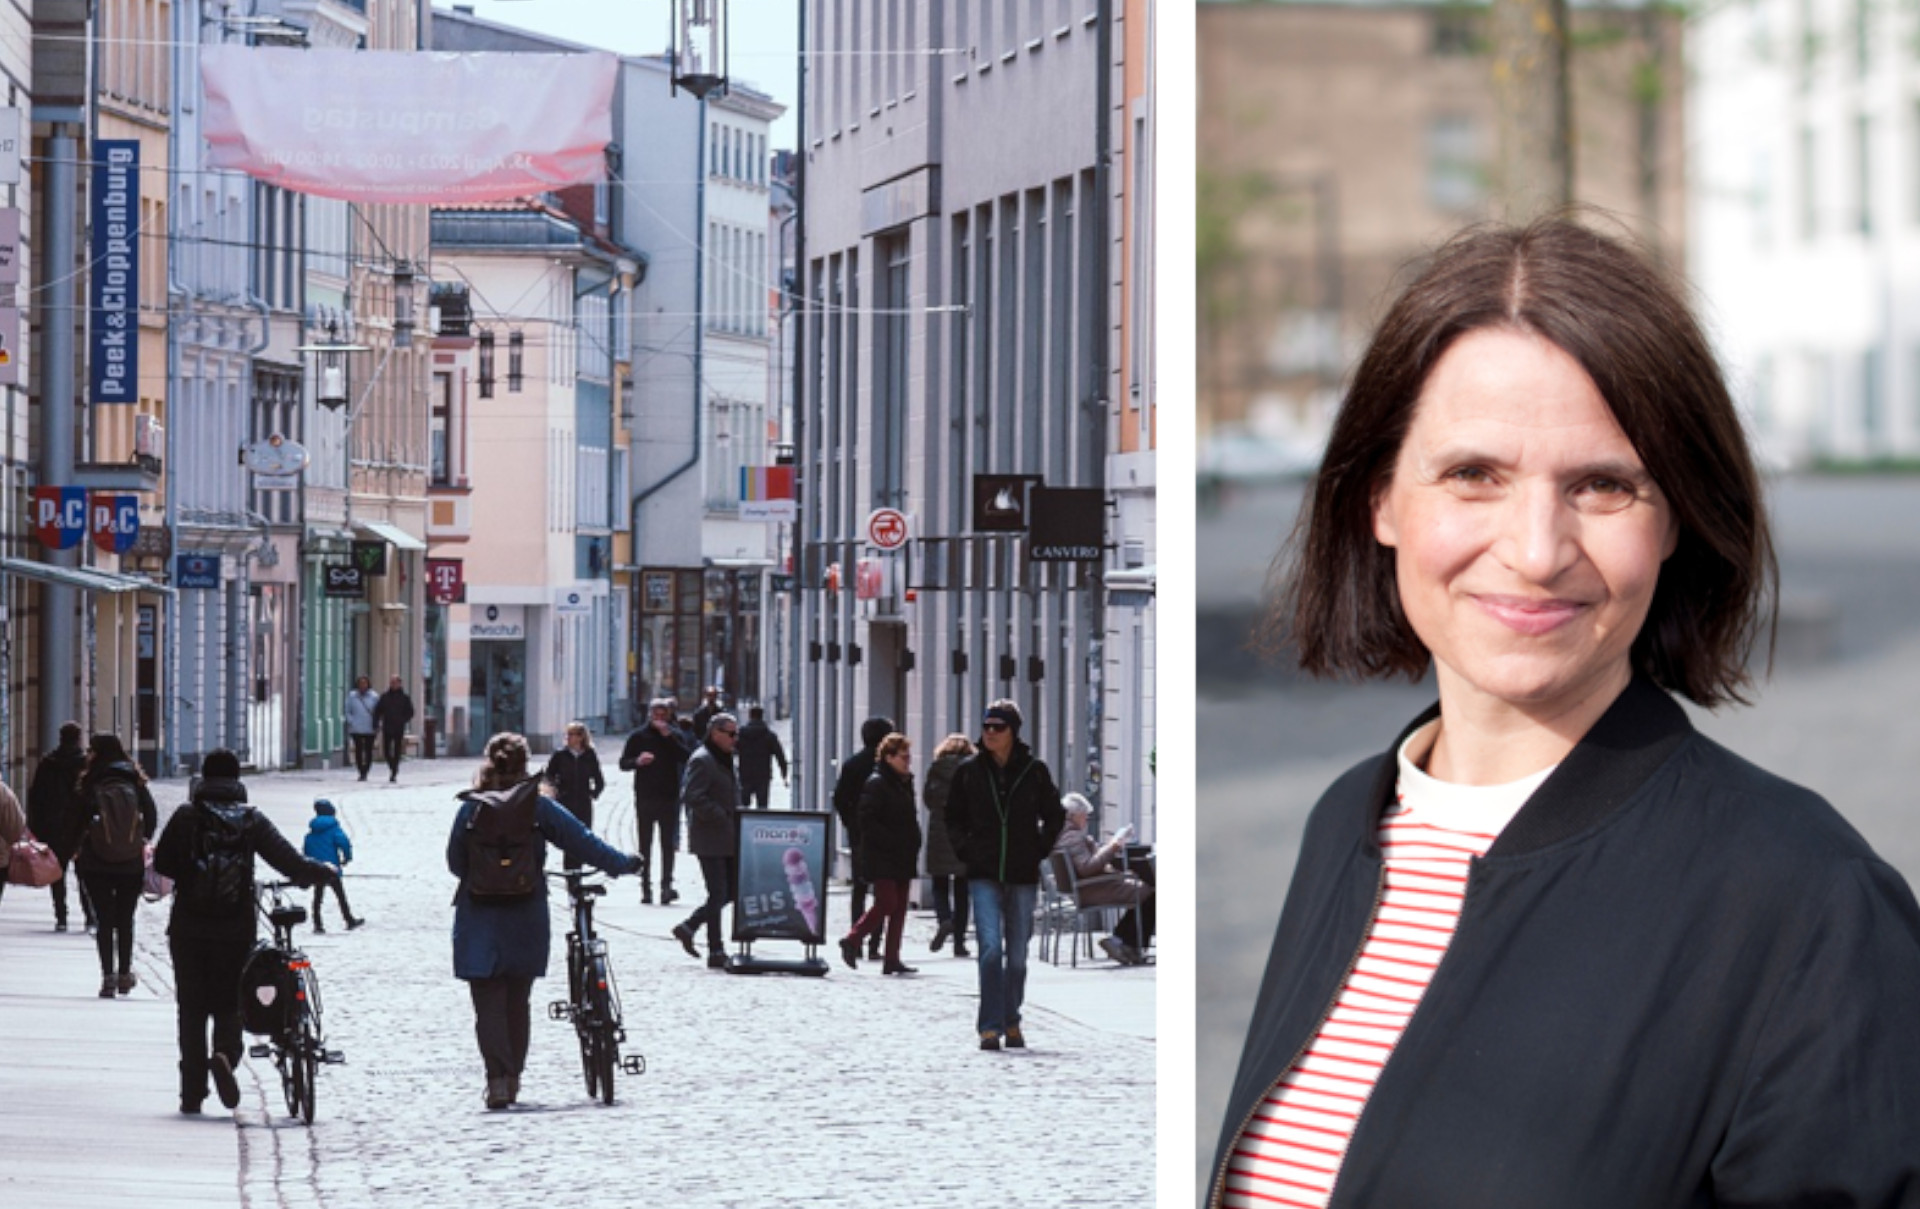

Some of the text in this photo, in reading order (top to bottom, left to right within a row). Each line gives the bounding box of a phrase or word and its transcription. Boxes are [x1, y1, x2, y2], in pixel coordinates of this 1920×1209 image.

[102, 147, 132, 395] Peek&Cloppenburg
[38, 498, 83, 529] P&C
[95, 504, 135, 533] P&C
[1032, 546, 1099, 559] CANVERO
[743, 890, 786, 915] EIS
